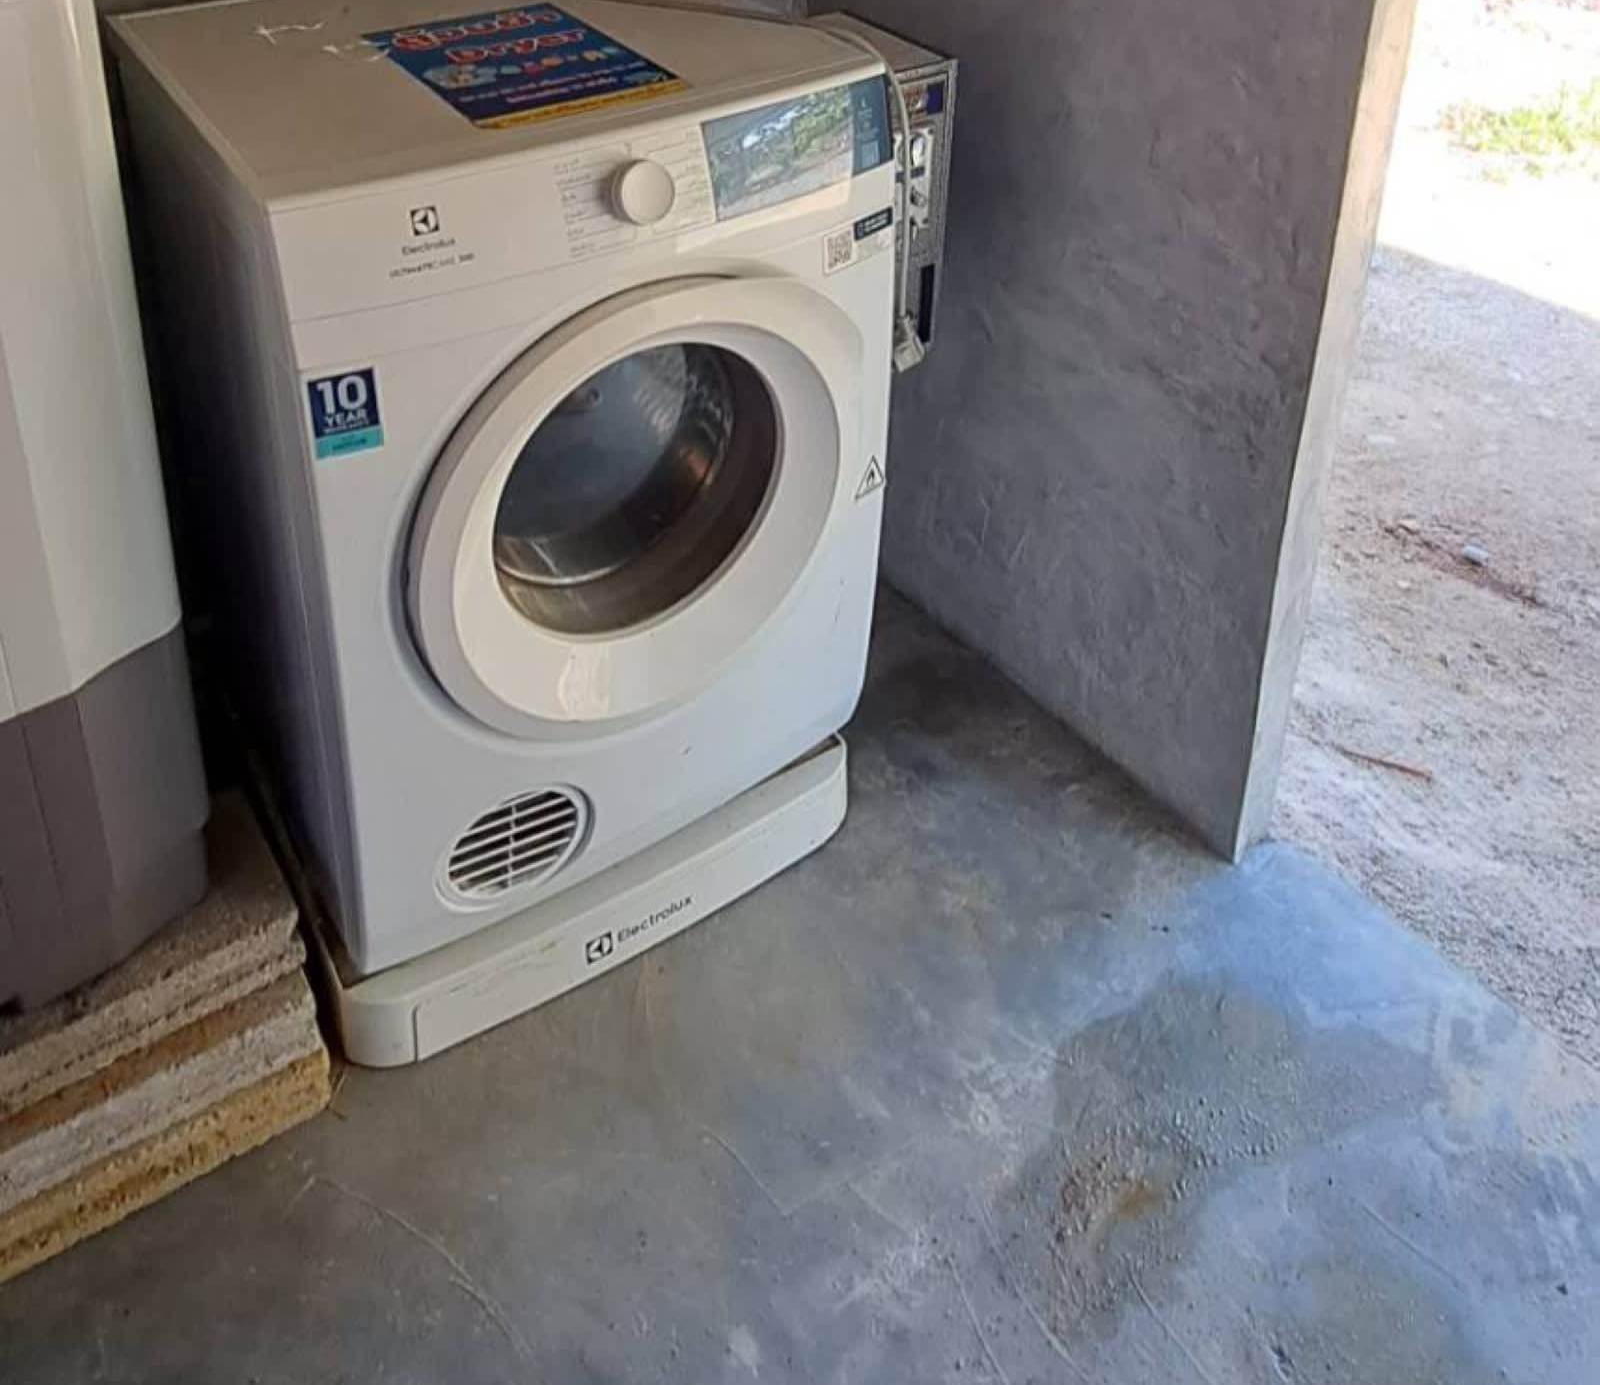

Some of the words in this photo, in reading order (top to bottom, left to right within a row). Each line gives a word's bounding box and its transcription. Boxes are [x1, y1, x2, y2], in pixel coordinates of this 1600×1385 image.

[446, 28, 586, 64] Dryer
[401, 237, 456, 256] Electrolux
[316, 375, 368, 415] 10
[324, 408, 370, 428] YEAR
[617, 895, 693, 943] Electrolux
